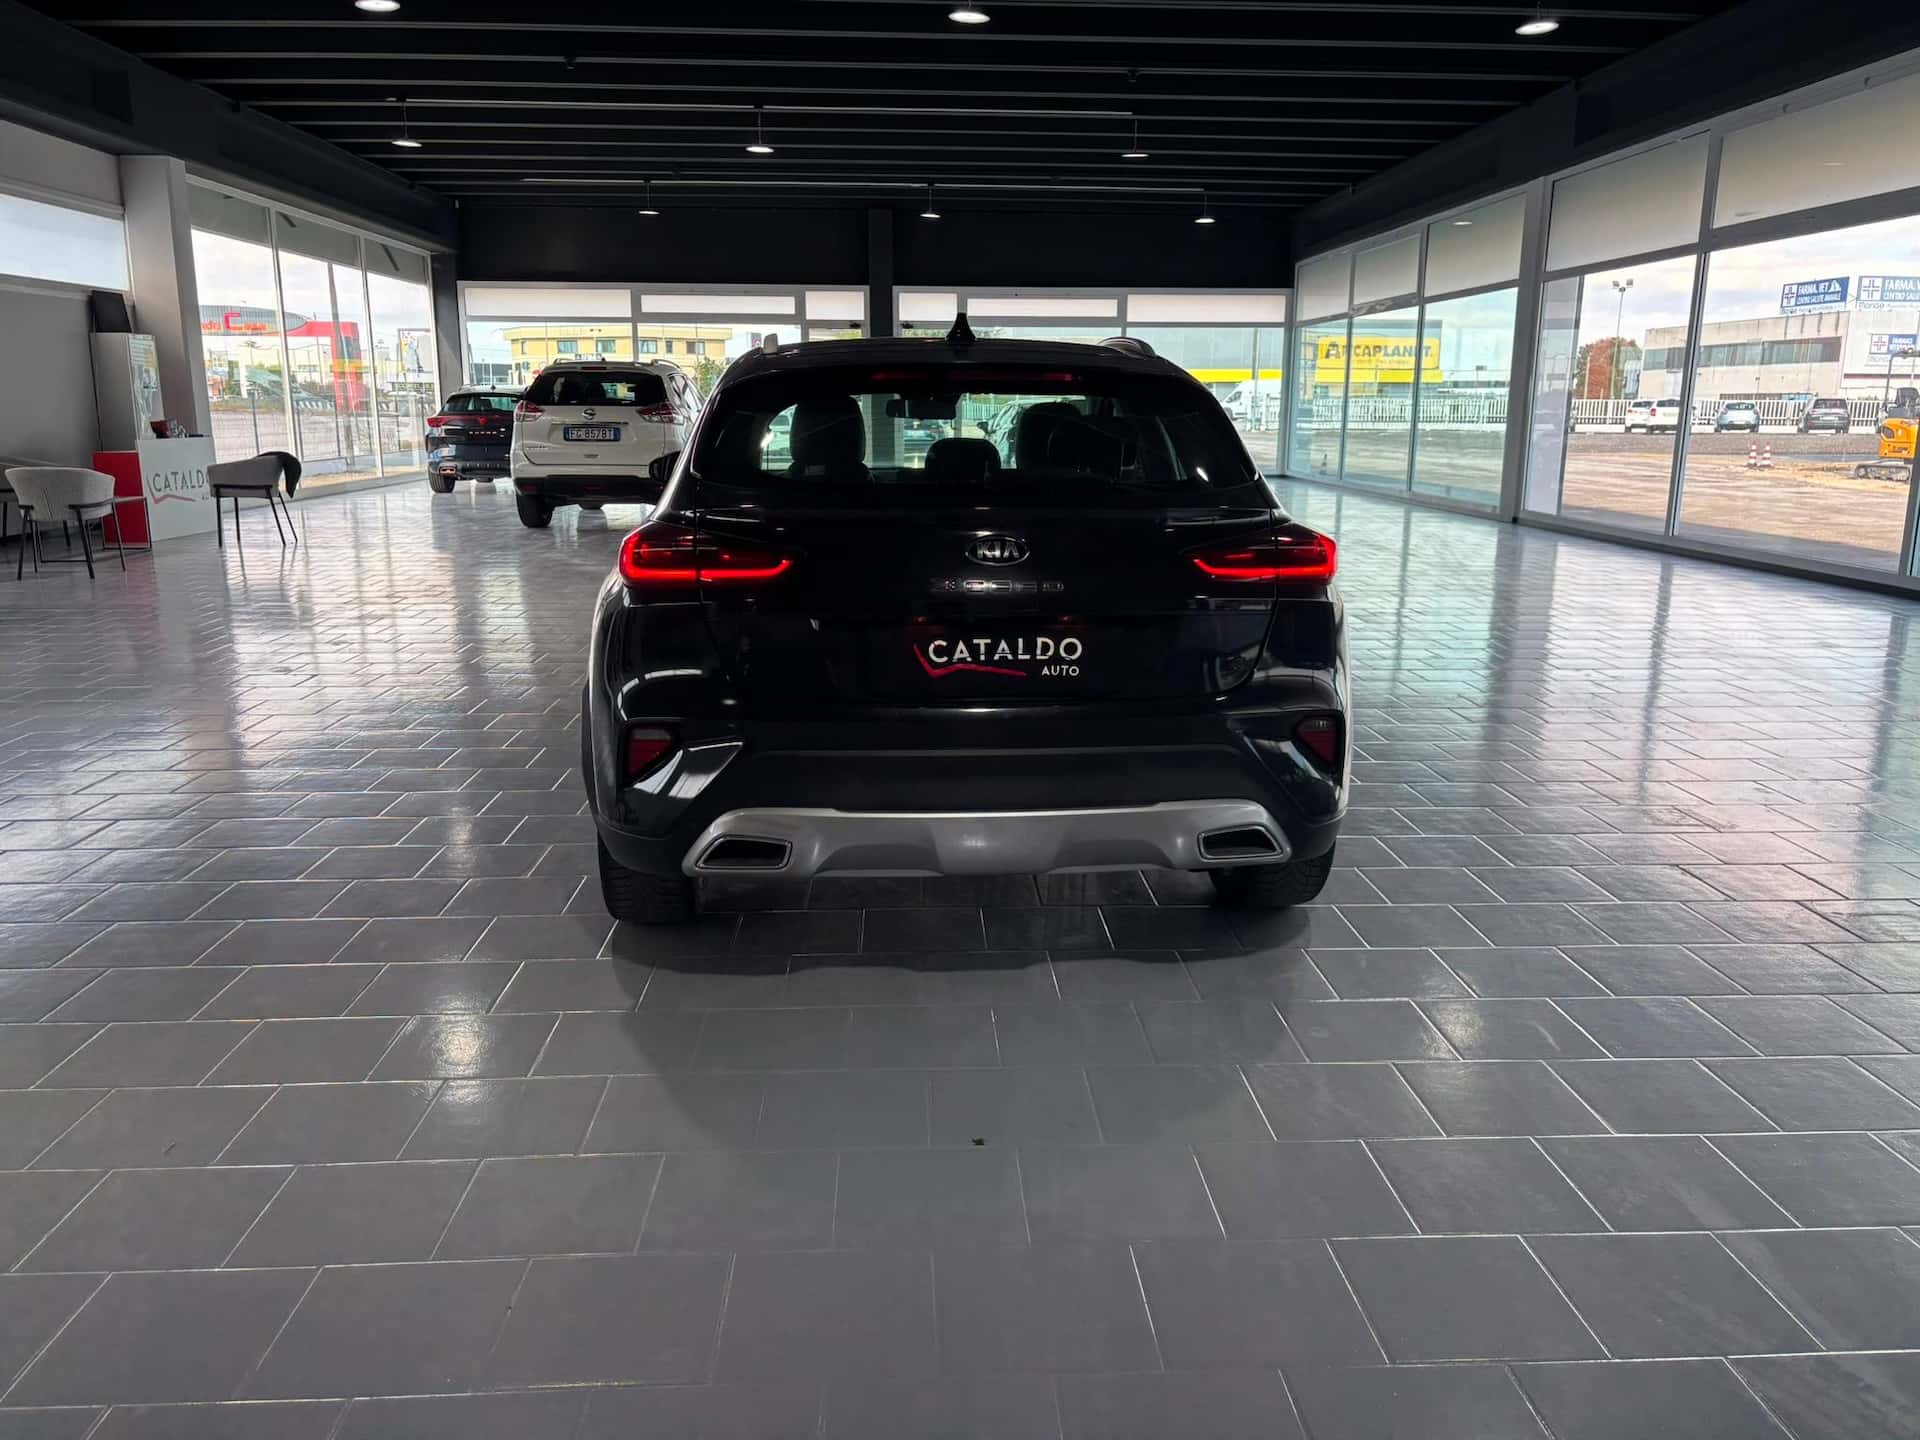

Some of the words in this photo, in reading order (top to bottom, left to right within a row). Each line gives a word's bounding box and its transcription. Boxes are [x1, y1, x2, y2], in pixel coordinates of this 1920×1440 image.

[1325, 342, 1431, 359] ACAPLANT
[976, 541, 1020, 559] KIA
[928, 637, 1083, 663] CATALDO
[1041, 665, 1080, 677] AUTO
